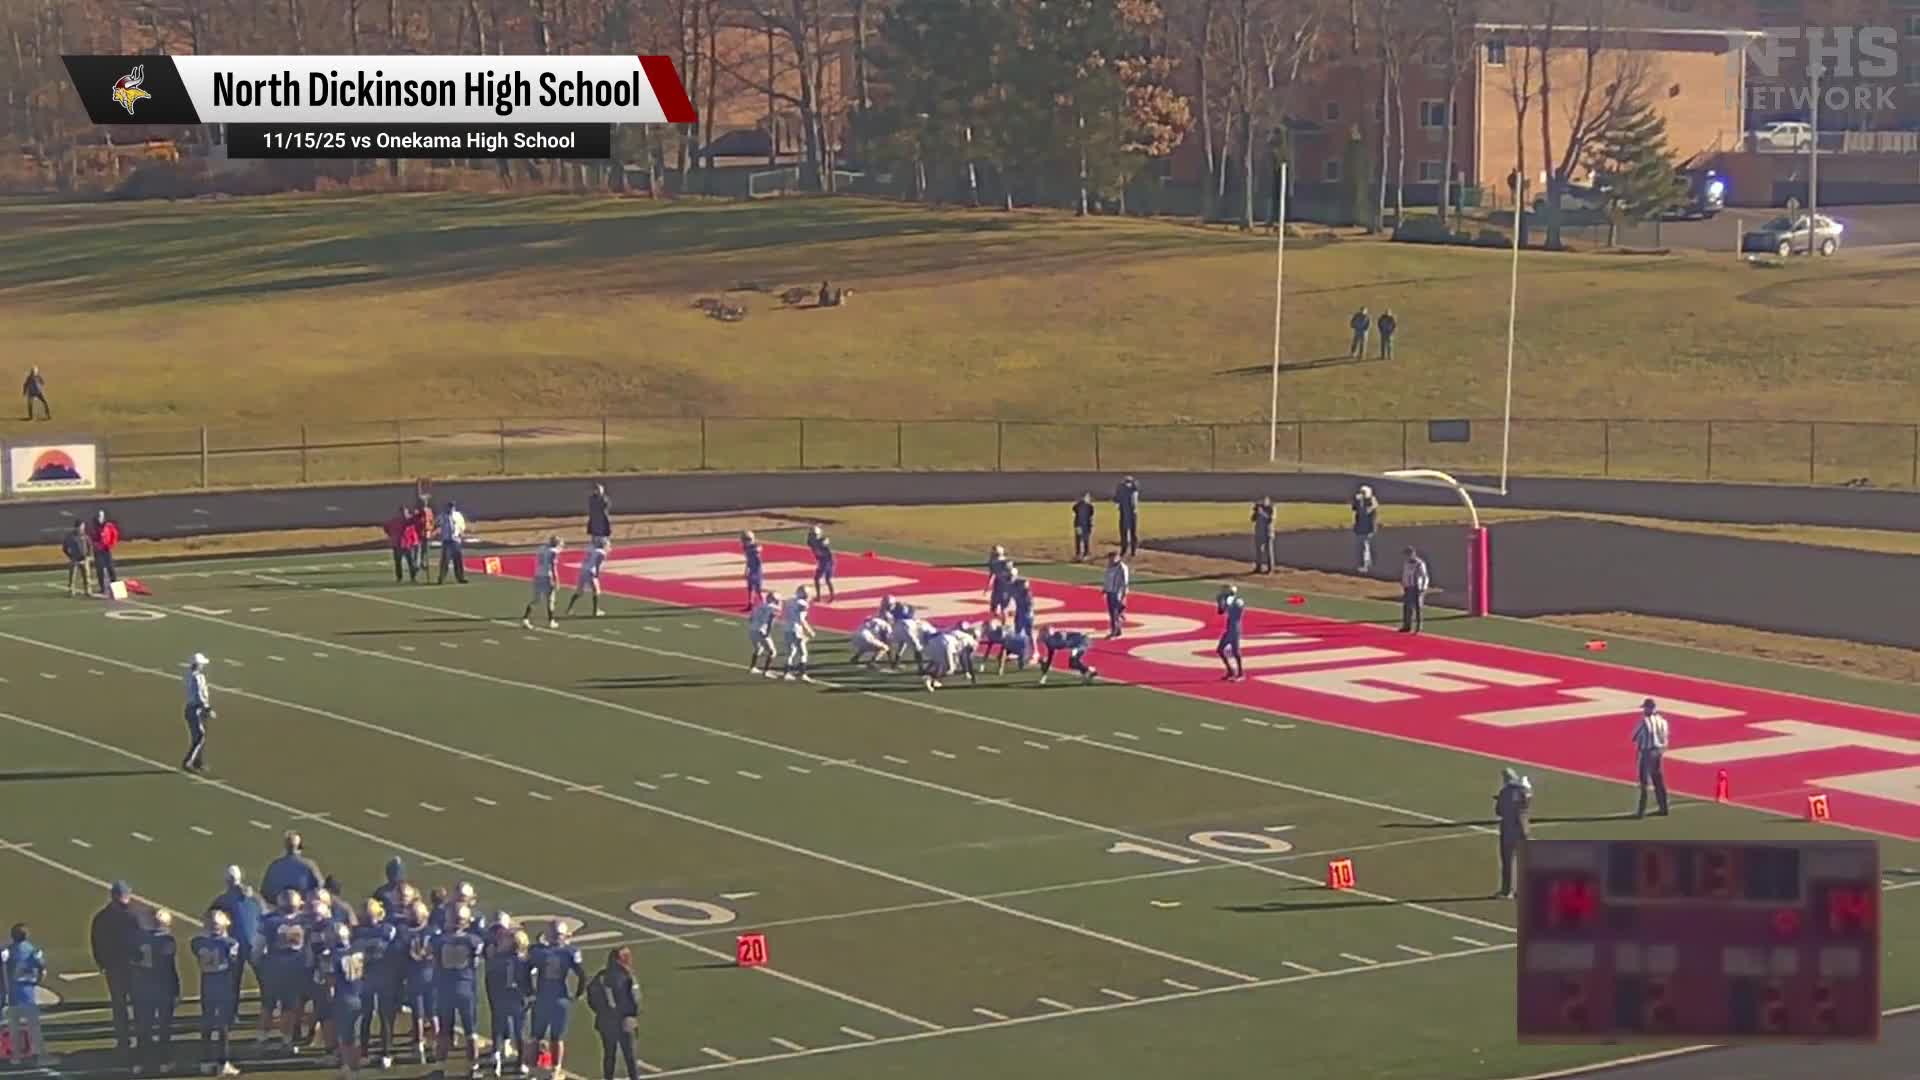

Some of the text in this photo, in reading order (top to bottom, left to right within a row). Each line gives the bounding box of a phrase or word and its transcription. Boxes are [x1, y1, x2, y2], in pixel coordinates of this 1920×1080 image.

[1813, 798, 1825, 818] G
[1107, 830, 1292, 865] 10
[1334, 864, 1351, 884] 10
[740, 938, 764, 962] 20
